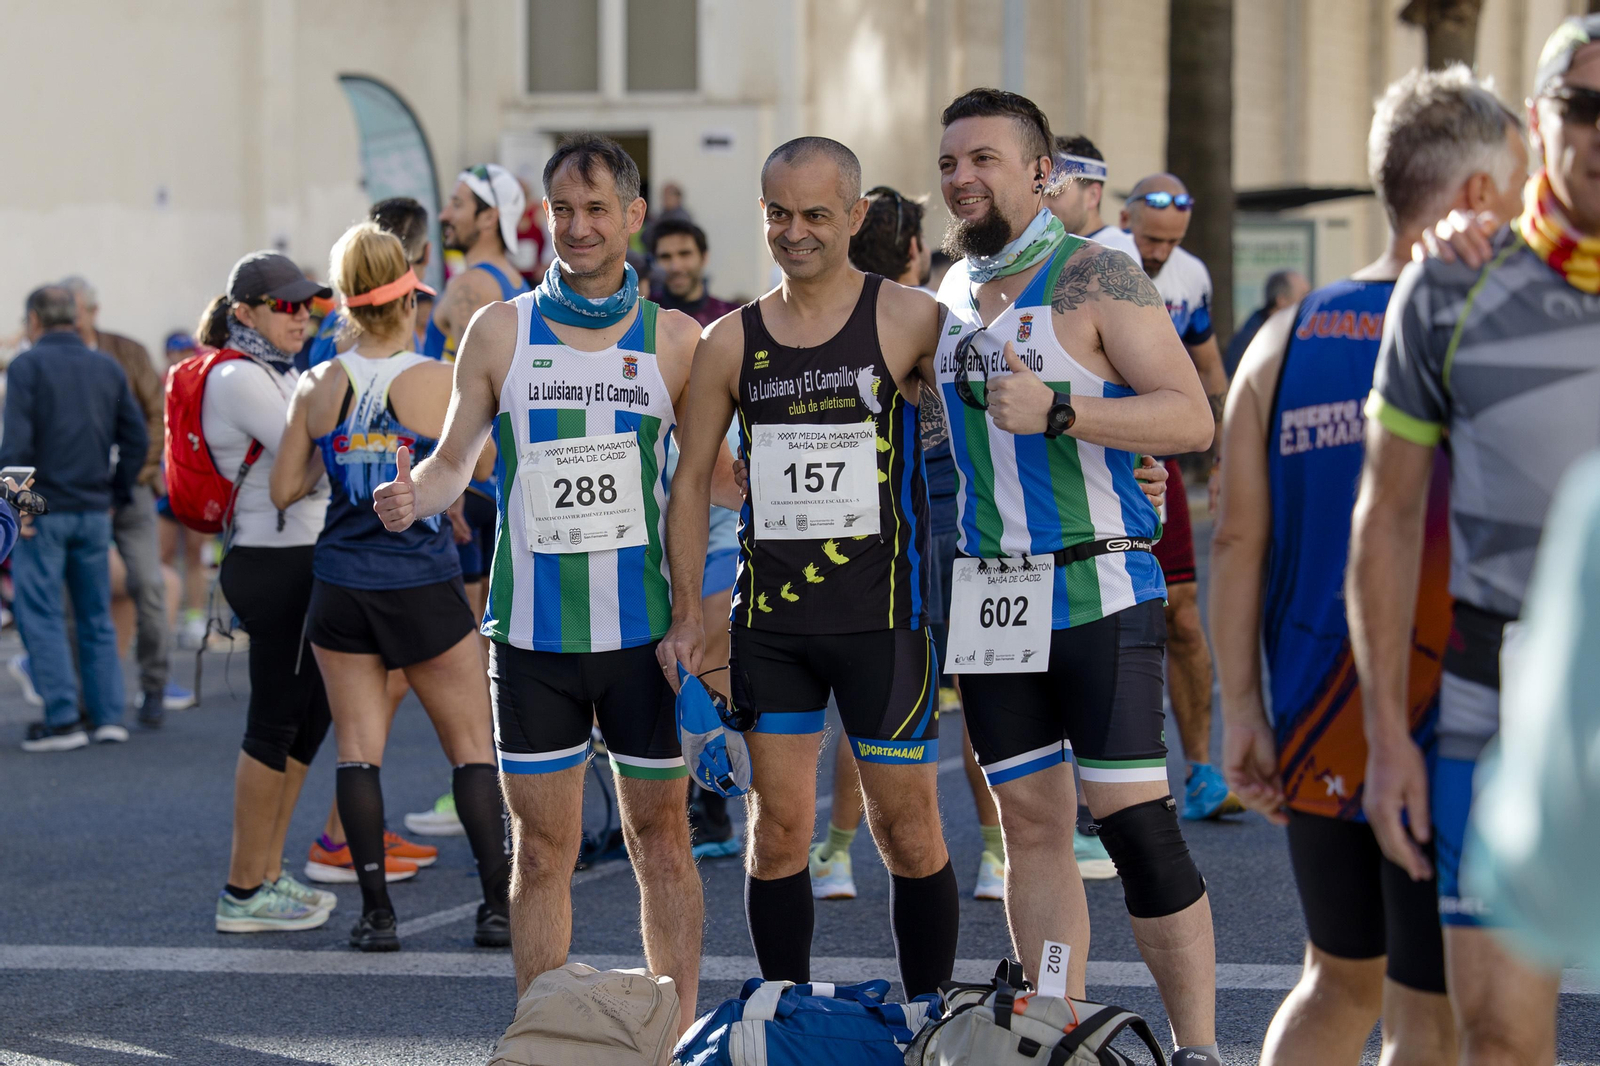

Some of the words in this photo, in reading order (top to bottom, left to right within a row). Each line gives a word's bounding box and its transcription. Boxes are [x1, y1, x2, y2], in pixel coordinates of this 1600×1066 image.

[1296, 310, 1384, 340] JUAN
[940, 353, 947, 374] La
[991, 350, 1000, 372] El
[528, 382, 539, 401] La
[542, 380, 583, 401] Luisiana
[586, 386, 592, 406] y
[595, 382, 604, 401] El
[607, 384, 649, 408] Campillo
[748, 382, 758, 402] La
[759, 377, 795, 400] Luisiana
[796, 378, 802, 399] y
[804, 370, 814, 392] El
[815, 366, 854, 393] Campillo
[788, 401, 806, 415] club
[808, 399, 818, 413] de
[820, 396, 856, 410] atletismo
[777, 432, 797, 440] XXXV
[798, 432, 827, 440] MEDIA
[829, 430, 873, 440] MARATÓN
[788, 441, 815, 450] BAHÍA
[830, 440, 860, 449] CÁDIZ
[544, 447, 565, 457] XXXV
[566, 444, 596, 454] MEDIA
[597, 440, 637, 452] MARATÓN
[556, 454, 585, 466] BAHÍA
[586, 454, 599, 463] DE
[600, 451, 627, 461] CÁDIZ
[784, 462, 846, 494] 157
[553, 474, 618, 509] 288
[988, 575, 1008, 584] BAHÍA
[1020, 574, 1042, 582] CÁDIZ
[980, 596, 1028, 628] 602
[858, 741, 925, 760] DEPORTEMANIA
[1047, 945, 1062, 974] 602
